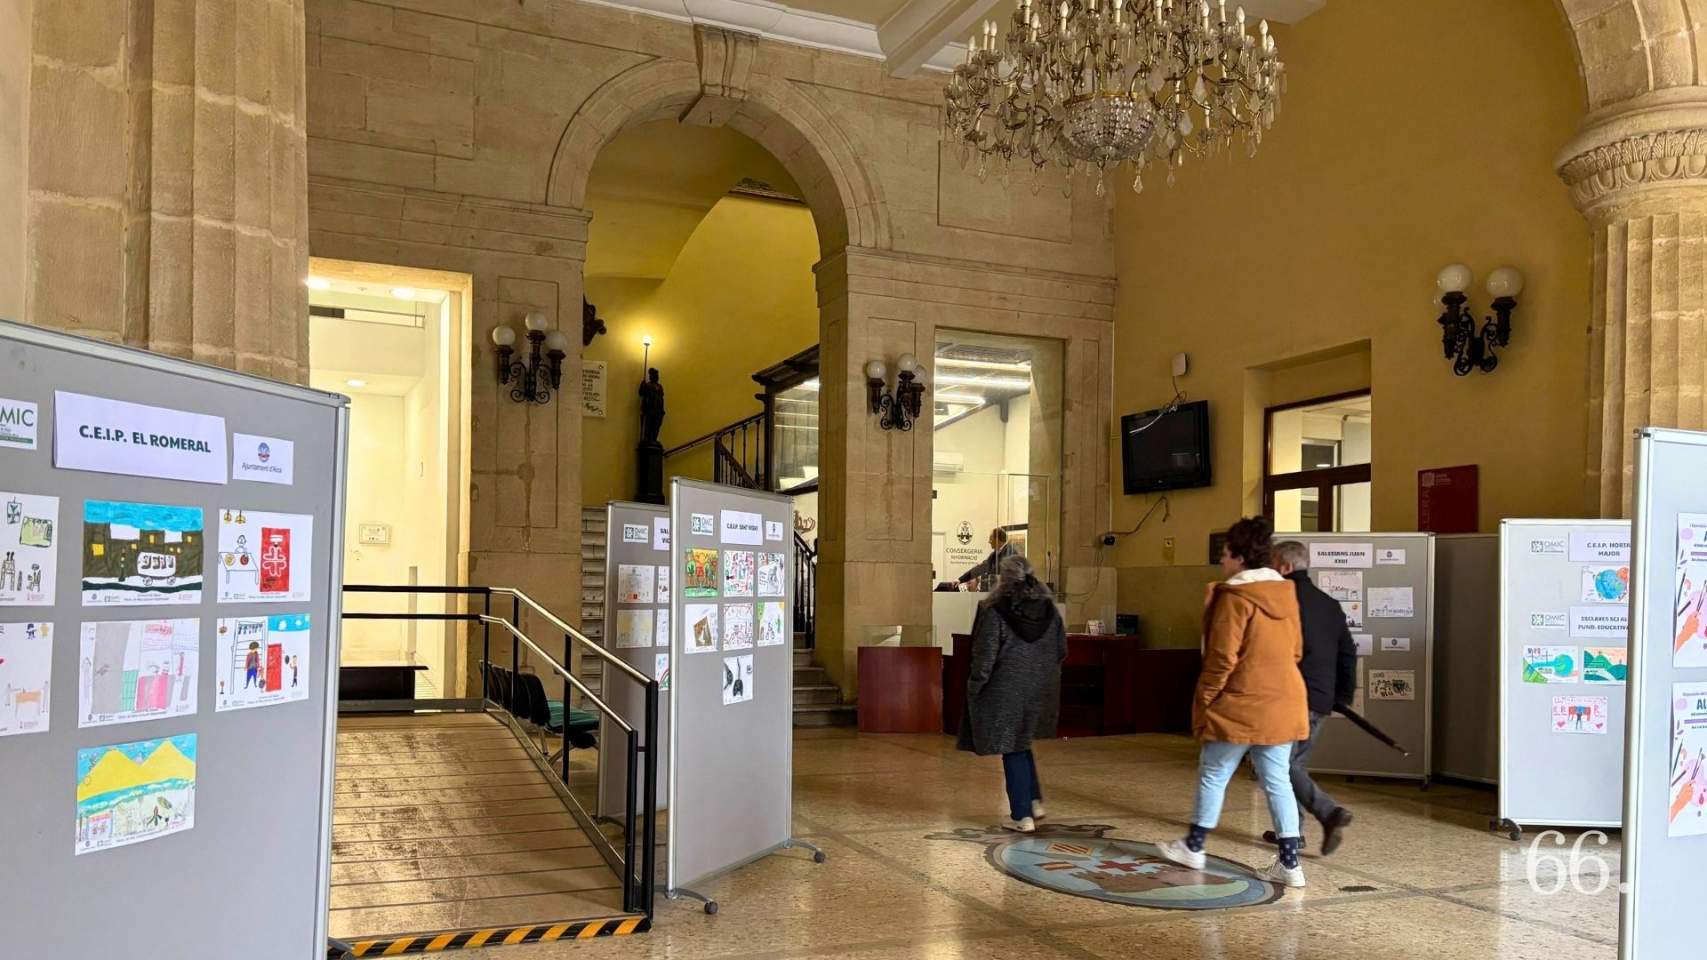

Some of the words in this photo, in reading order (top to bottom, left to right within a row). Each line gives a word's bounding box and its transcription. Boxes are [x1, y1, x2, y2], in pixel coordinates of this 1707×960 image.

[0, 406, 34, 427] MIC
[79, 424, 127, 443] C.E.I.P.
[132, 431, 148, 446] EL
[149, 433, 212, 453] ROMERAL
